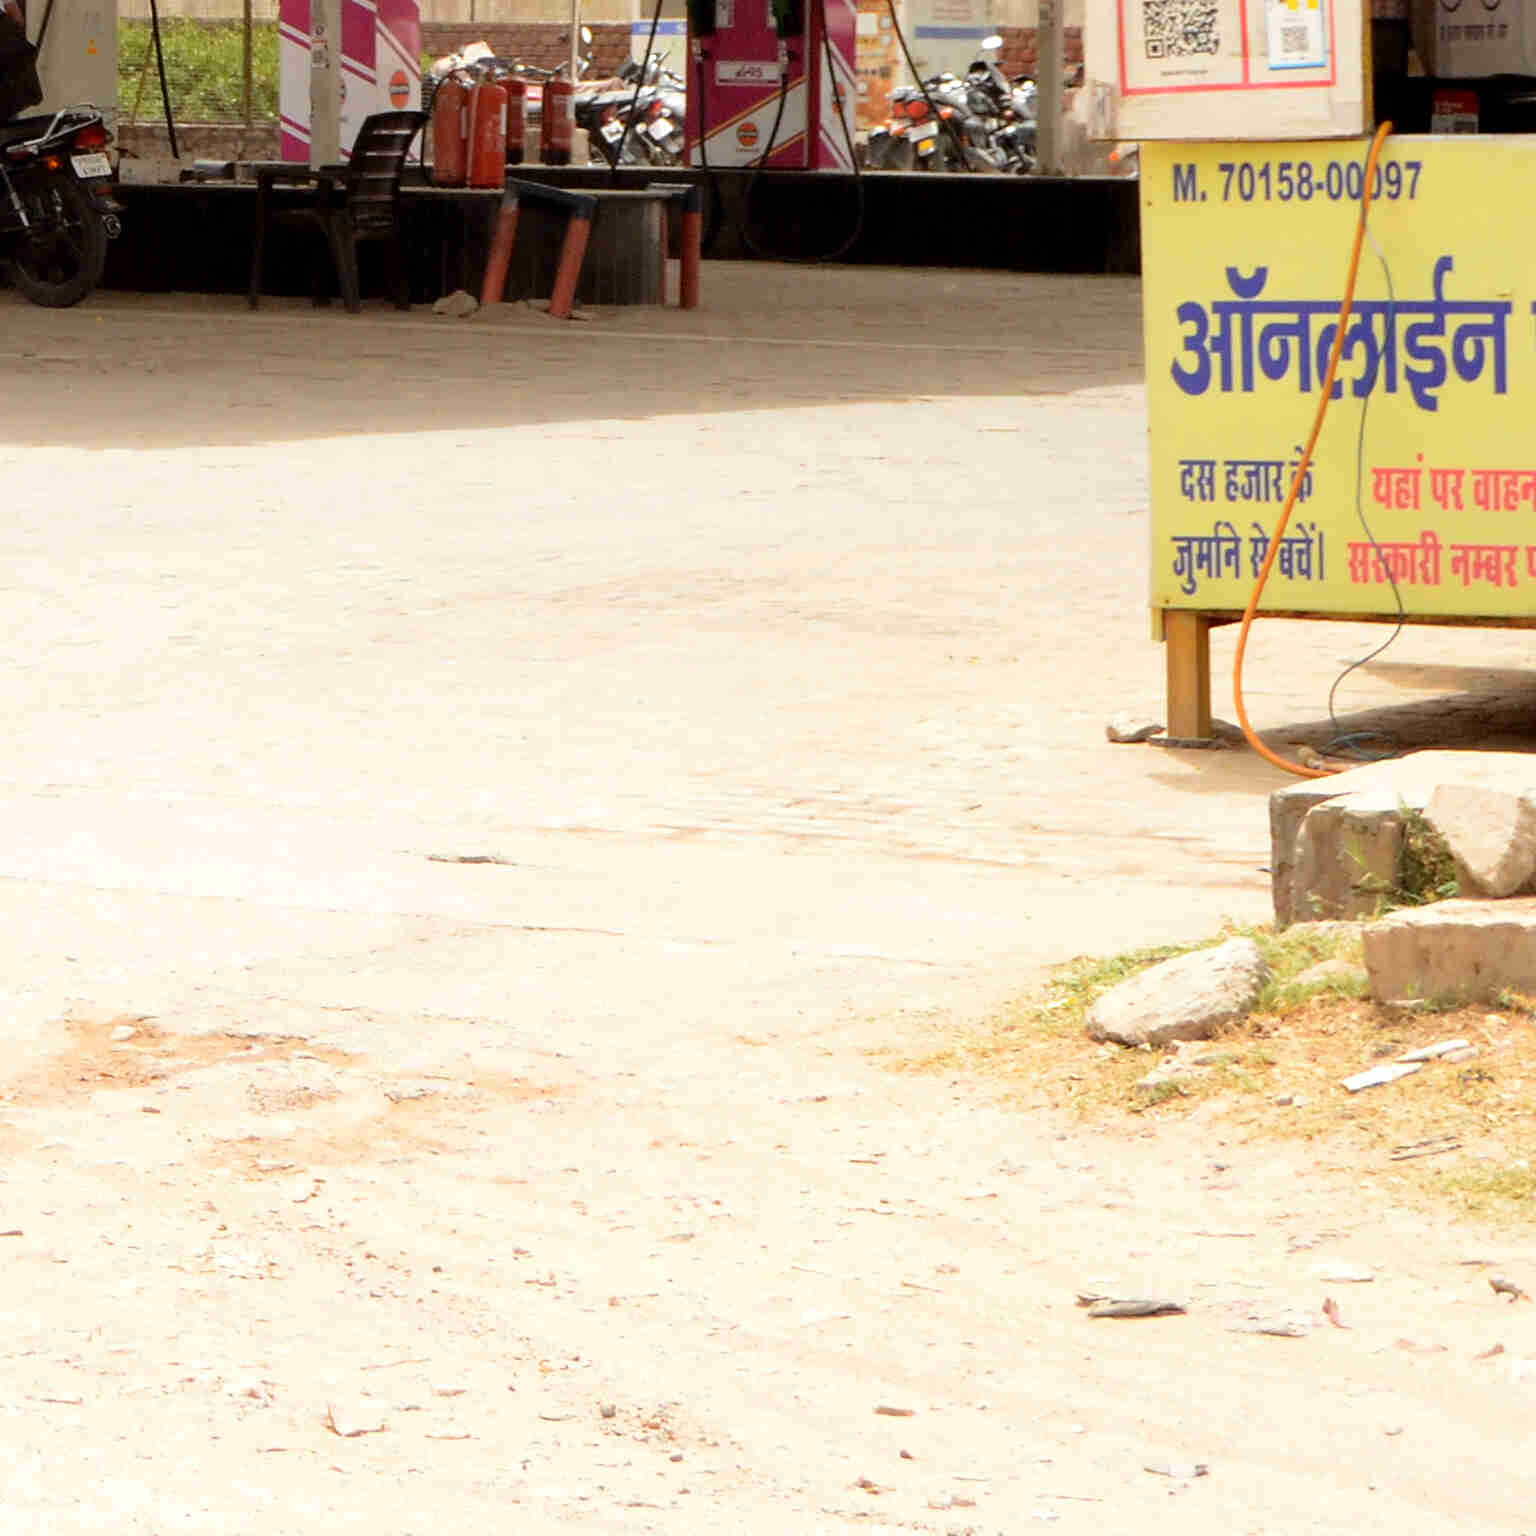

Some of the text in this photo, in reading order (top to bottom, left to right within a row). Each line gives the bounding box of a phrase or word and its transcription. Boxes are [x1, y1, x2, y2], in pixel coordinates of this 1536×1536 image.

[1173, 163, 1207, 201] M.
[1171, 255, 1512, 412] ऑनलाईन
[1178, 459, 1217, 503] दस
[1223, 460, 1285, 503] हजार
[1372, 452, 1422, 510] यहां
[1429, 467, 1465, 511] पर
[1347, 529, 1442, 585] सरकारी
[1449, 543, 1519, 588] नम्बर
